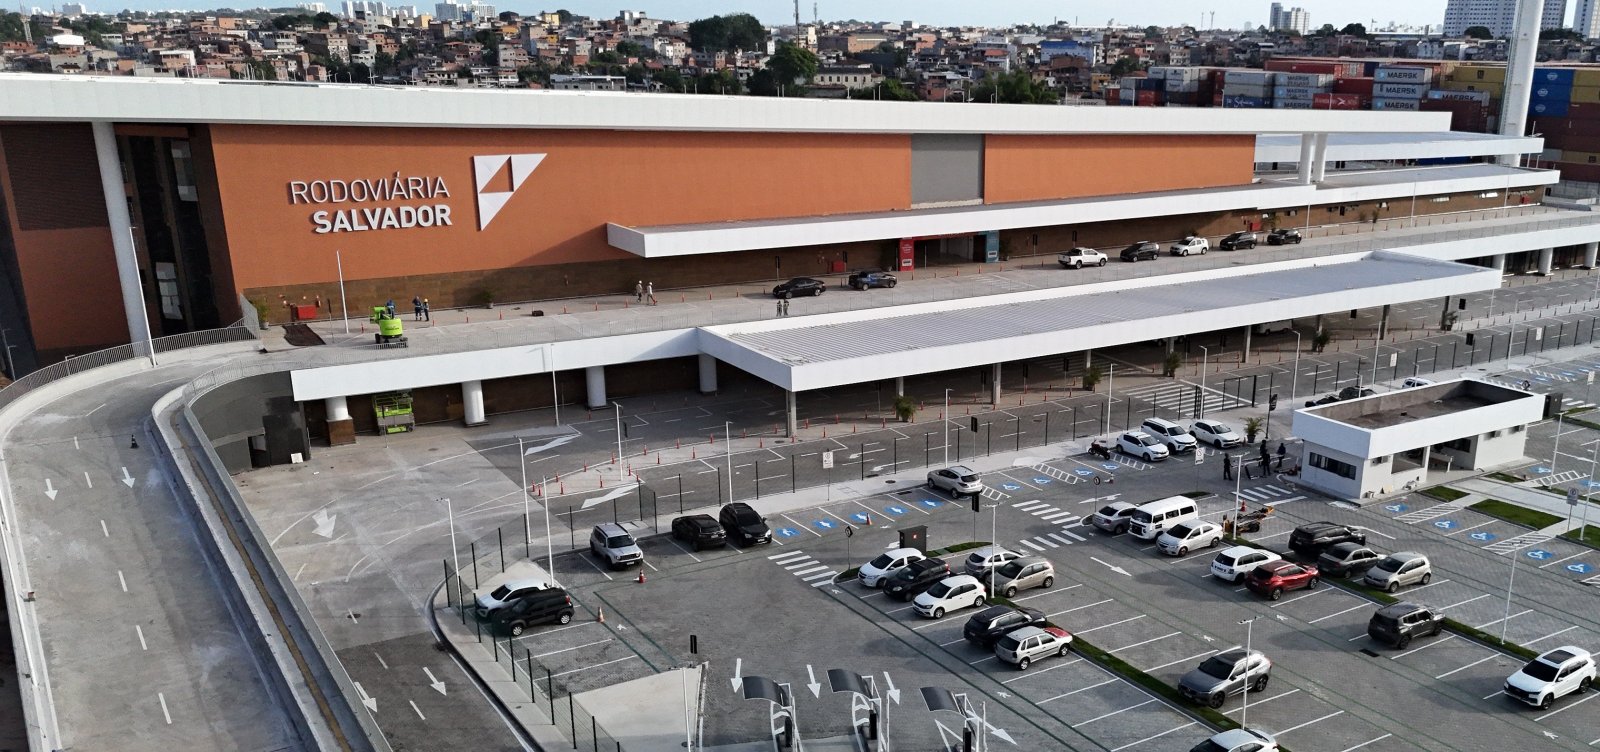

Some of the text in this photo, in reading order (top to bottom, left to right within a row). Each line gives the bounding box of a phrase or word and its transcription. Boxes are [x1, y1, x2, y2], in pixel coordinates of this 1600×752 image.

[1386, 87, 1416, 95] MAERSK
[1384, 101, 1414, 109] MAERSK
[288, 170, 450, 204] RODOVIÁRIA
[312, 204, 452, 234] SALVADOR
